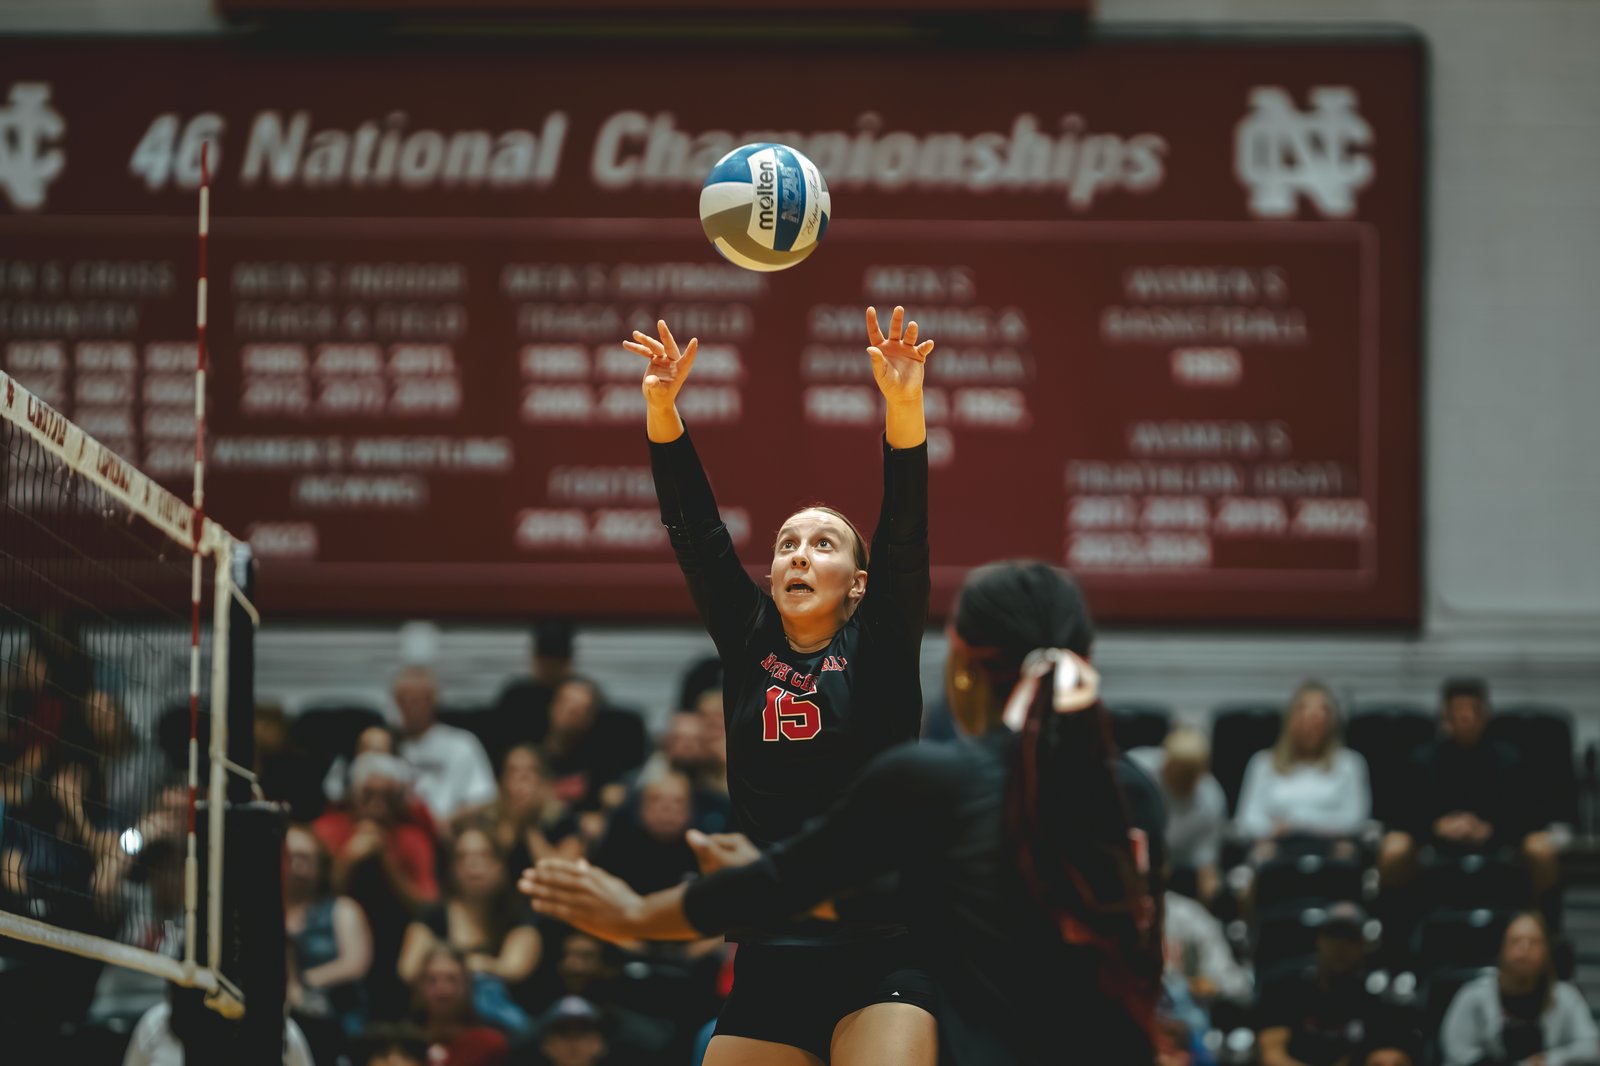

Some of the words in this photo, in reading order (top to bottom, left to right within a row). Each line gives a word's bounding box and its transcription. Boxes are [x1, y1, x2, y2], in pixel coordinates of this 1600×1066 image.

[129, 113, 224, 192] 46
[242, 110, 569, 187] National
[757, 161, 774, 231] molten
[763, 685, 821, 741] 15
